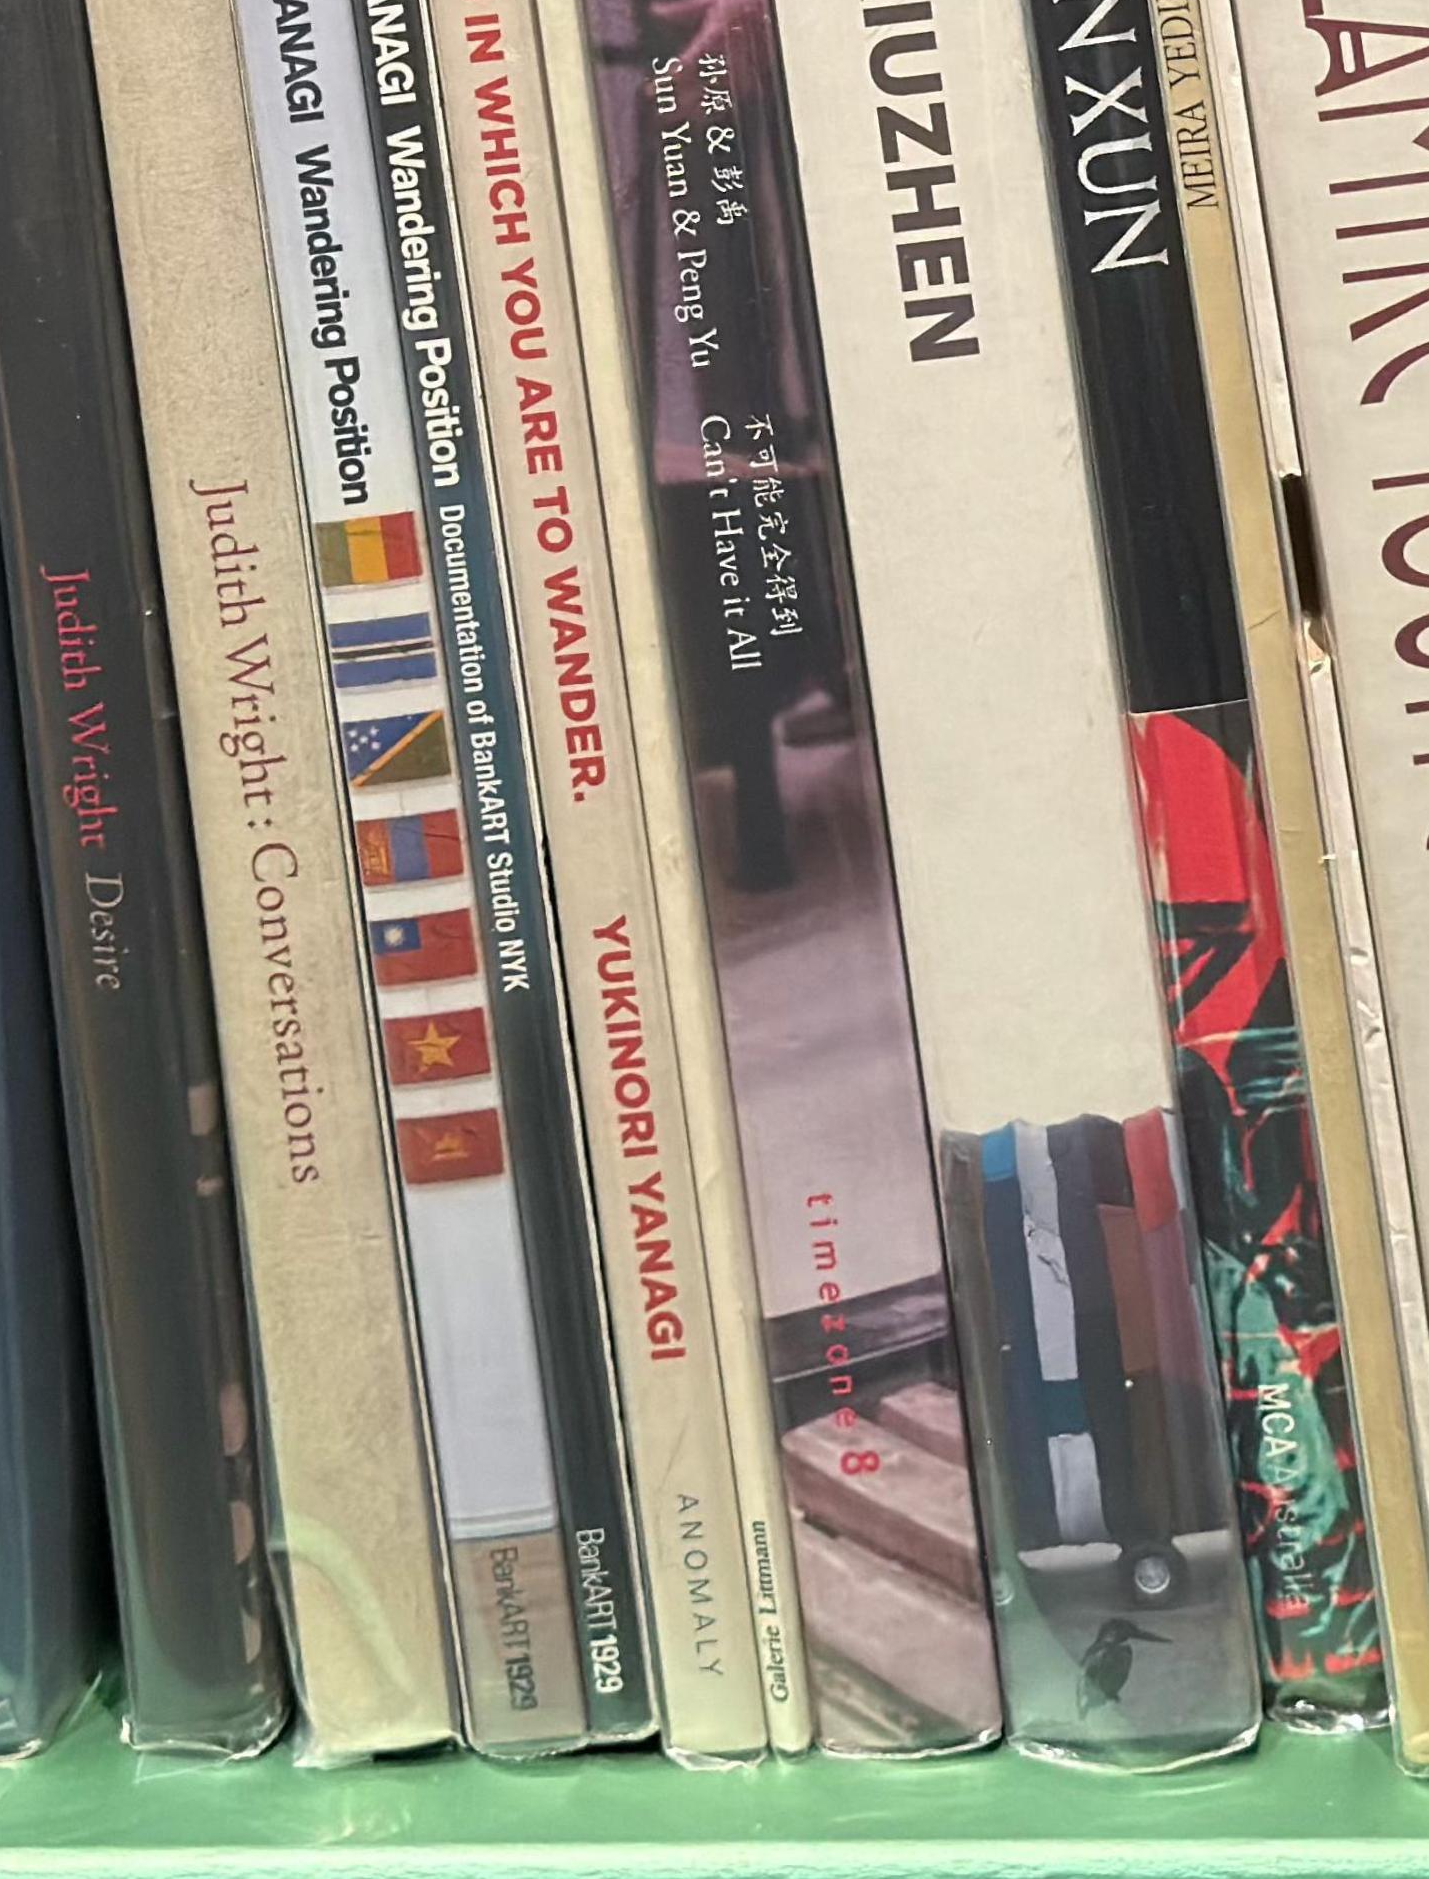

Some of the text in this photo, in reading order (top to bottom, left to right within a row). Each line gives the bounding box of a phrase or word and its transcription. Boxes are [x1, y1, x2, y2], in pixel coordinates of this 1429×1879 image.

[463, 12, 506, 65] IN
[385, 124, 443, 332] Wandering
[473, 74, 532, 246] WHICH
[651, 56, 720, 369] Sun Yuan Peng Yu
[1067, 66, 1170, 276] XUN
[1172, 99, 1219, 210] MEIRA
[294, 143, 351, 350] Wandering
[323, 355, 374, 507] Position
[413, 337, 465, 488] Position
[499, 255, 549, 361] YOU
[514, 375, 564, 476] ARE
[531, 484, 575, 554] TO
[743, 412, 804, 637] 不可能完全得到
[699, 414, 763, 671] Can't Have it All
[38, 564, 130, 991] Judith Wright Desire
[438, 503, 531, 994] Documentation of BankART Studio NYK
[543, 564, 607, 804] WANDER.
[186, 478, 325, 1185] Judith Wright Conversations
[591, 914, 687, 1361] YUKINORI YANAGI
[676, 1492, 726, 1679] ANOMALY
